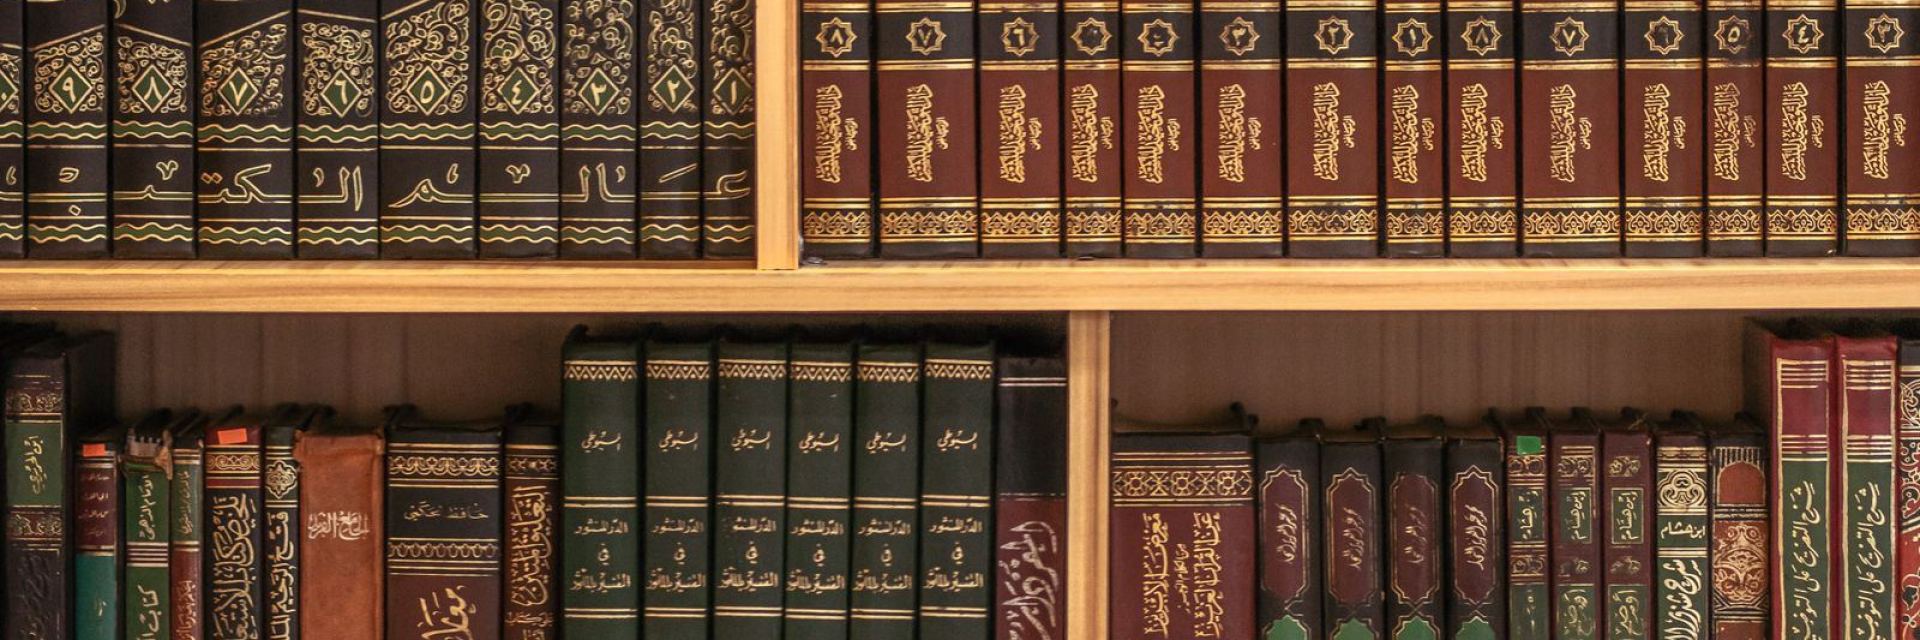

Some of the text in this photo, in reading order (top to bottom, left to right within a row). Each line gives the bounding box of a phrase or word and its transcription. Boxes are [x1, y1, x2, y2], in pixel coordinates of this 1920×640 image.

[830, 29, 844, 45] ٨
[919, 28, 932, 45] ٧
[1012, 28, 1025, 46] ٦
[1409, 28, 1417, 45] ١
[1476, 28, 1488, 44] ٨
[1563, 28, 1575, 45] ٧
[1728, 27, 1740, 43] ٥
[1798, 25, 1809, 44] ٤
[62, 77, 76, 103] ٩
[143, 76, 162, 101] ٨
[229, 81, 248, 106] ٧
[334, 79, 348, 104] ٦
[420, 80, 434, 104] ٥
[511, 79, 523, 103] ٤
[731, 80, 737, 103] ١
[1790, 481, 1820, 524] شرح
[1855, 481, 1885, 525] شرح
[1661, 521, 1706, 538] ابن هشام
[597, 543, 610, 566] في
[673, 542, 687, 565] في
[745, 541, 759, 564] في
[812, 543, 826, 567] في
[880, 543, 893, 567] في
[951, 541, 964, 565] في
[1792, 521, 1820, 567] التصريح
[1857, 521, 1885, 568] التصريح
[267, 511, 296, 613] فتح الرحيم
[138, 584, 162, 632] كتاب
[1856, 589, 1887, 640] التوضي
